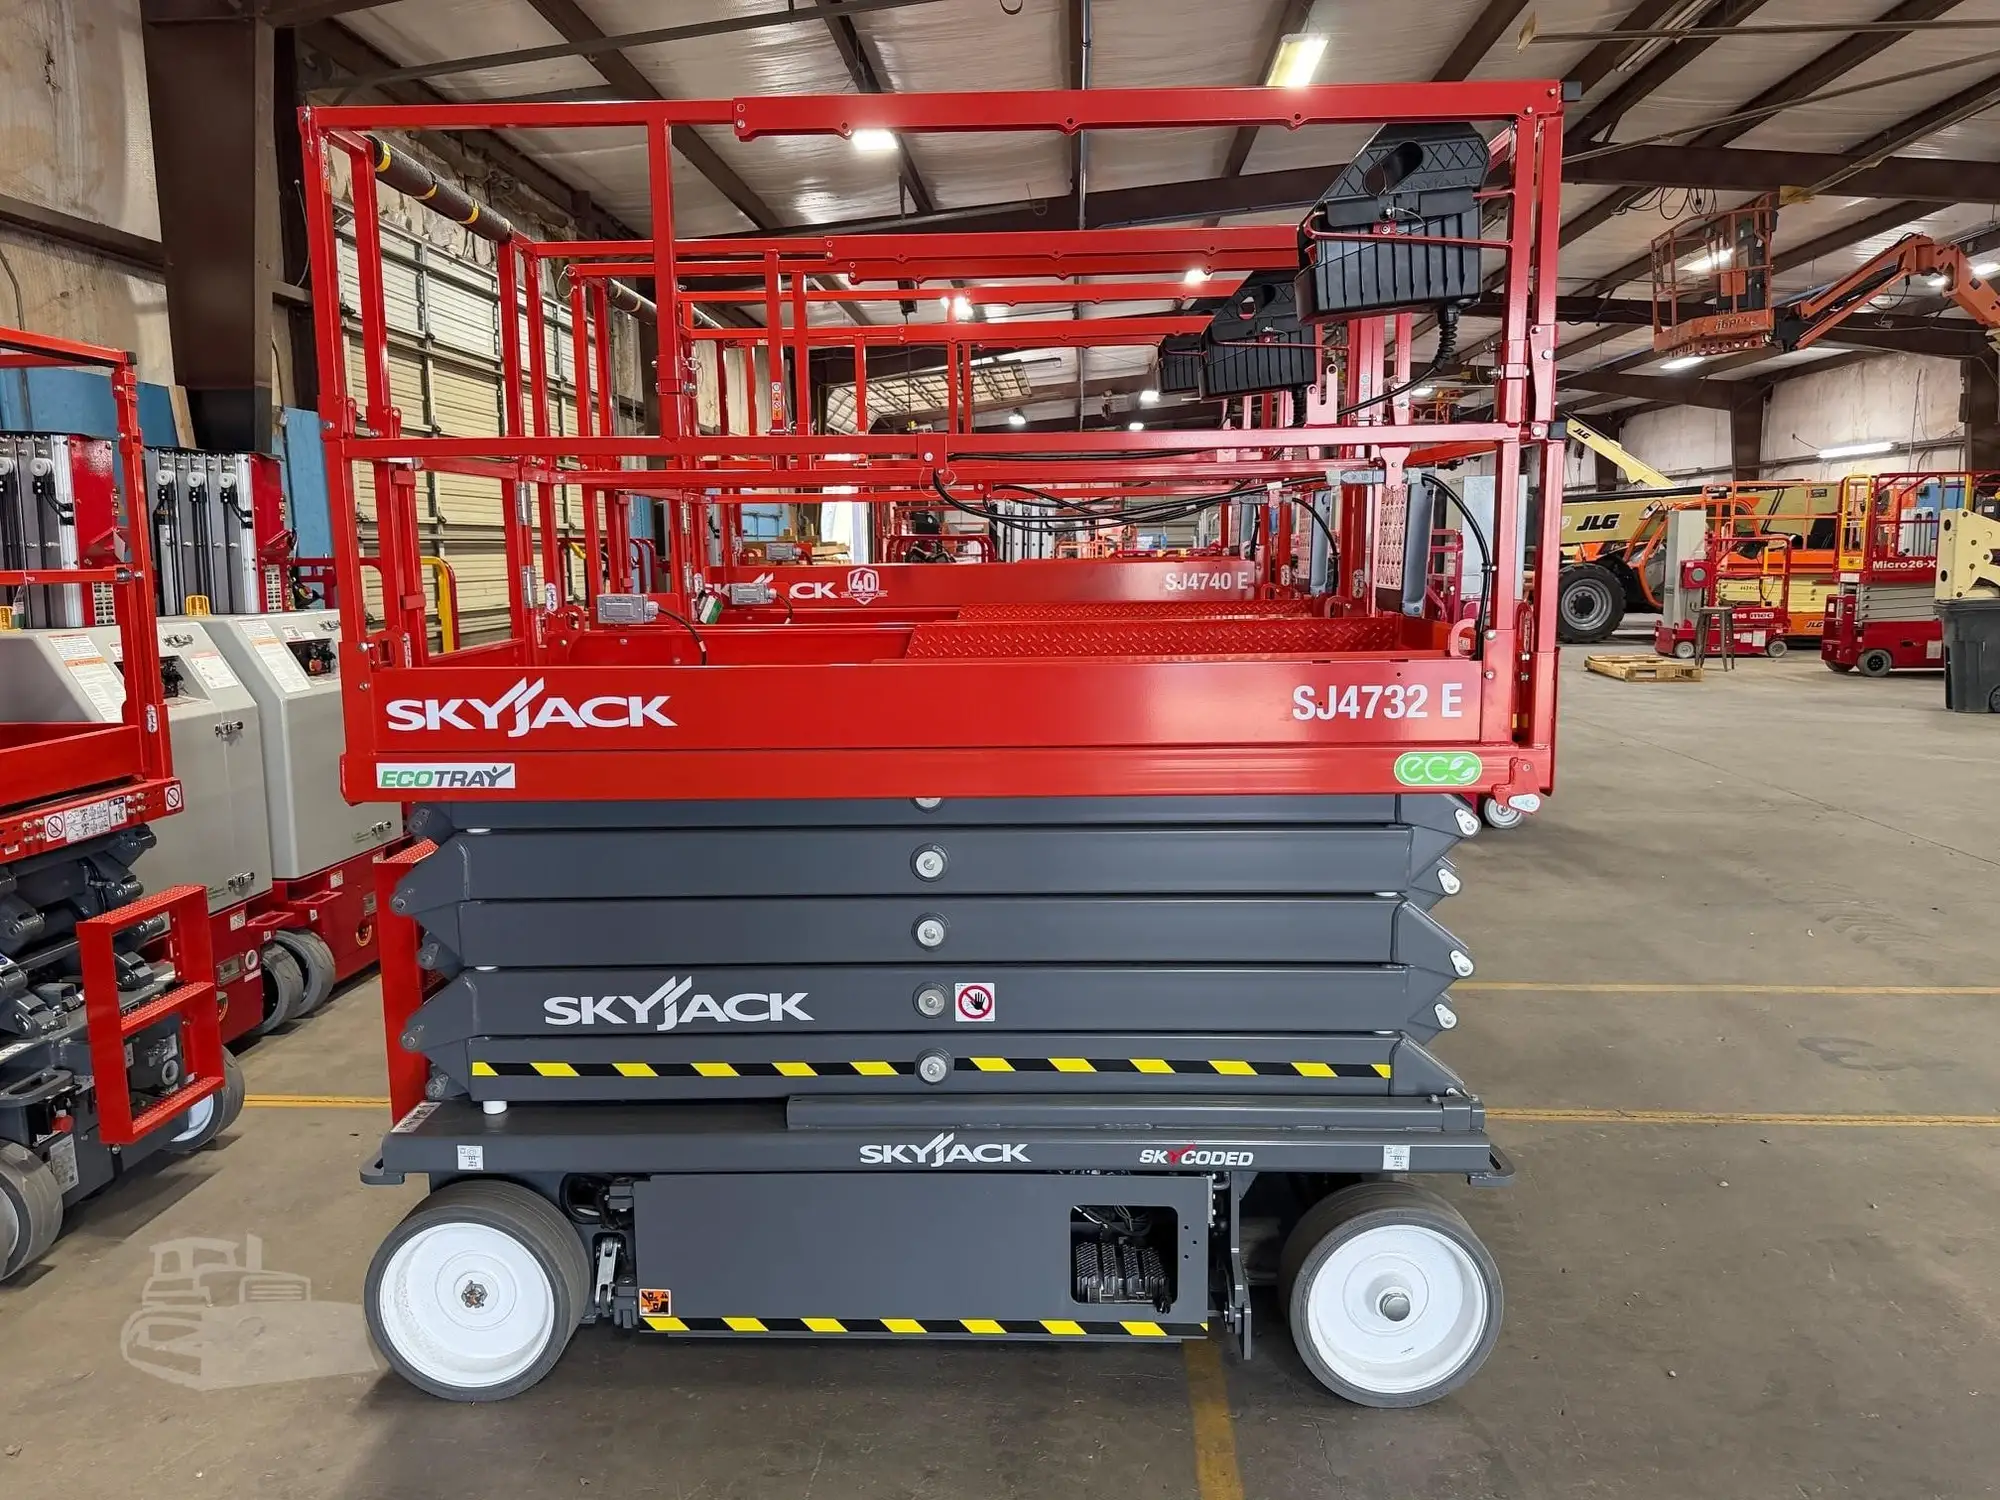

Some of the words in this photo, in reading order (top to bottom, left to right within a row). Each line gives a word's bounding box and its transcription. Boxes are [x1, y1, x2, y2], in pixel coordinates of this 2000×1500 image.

[1573, 428, 1591, 439] JLG
[1577, 514, 1620, 531] JLG
[704, 572, 839, 599] SKCK
[852, 572, 875, 591] 40
[1165, 572, 1231, 590] SJ4740
[1237, 571, 1248, 589] E
[386, 677, 678, 738] SKYJACK
[1293, 684, 1428, 720] SJ4732
[1441, 683, 1462, 717] E
[381, 765, 512, 787] ECOTRAY
[543, 976, 815, 1031] SKYJACK
[859, 1132, 1032, 1167] SKYJACK
[1139, 1143, 1254, 1168] SKYCODED
